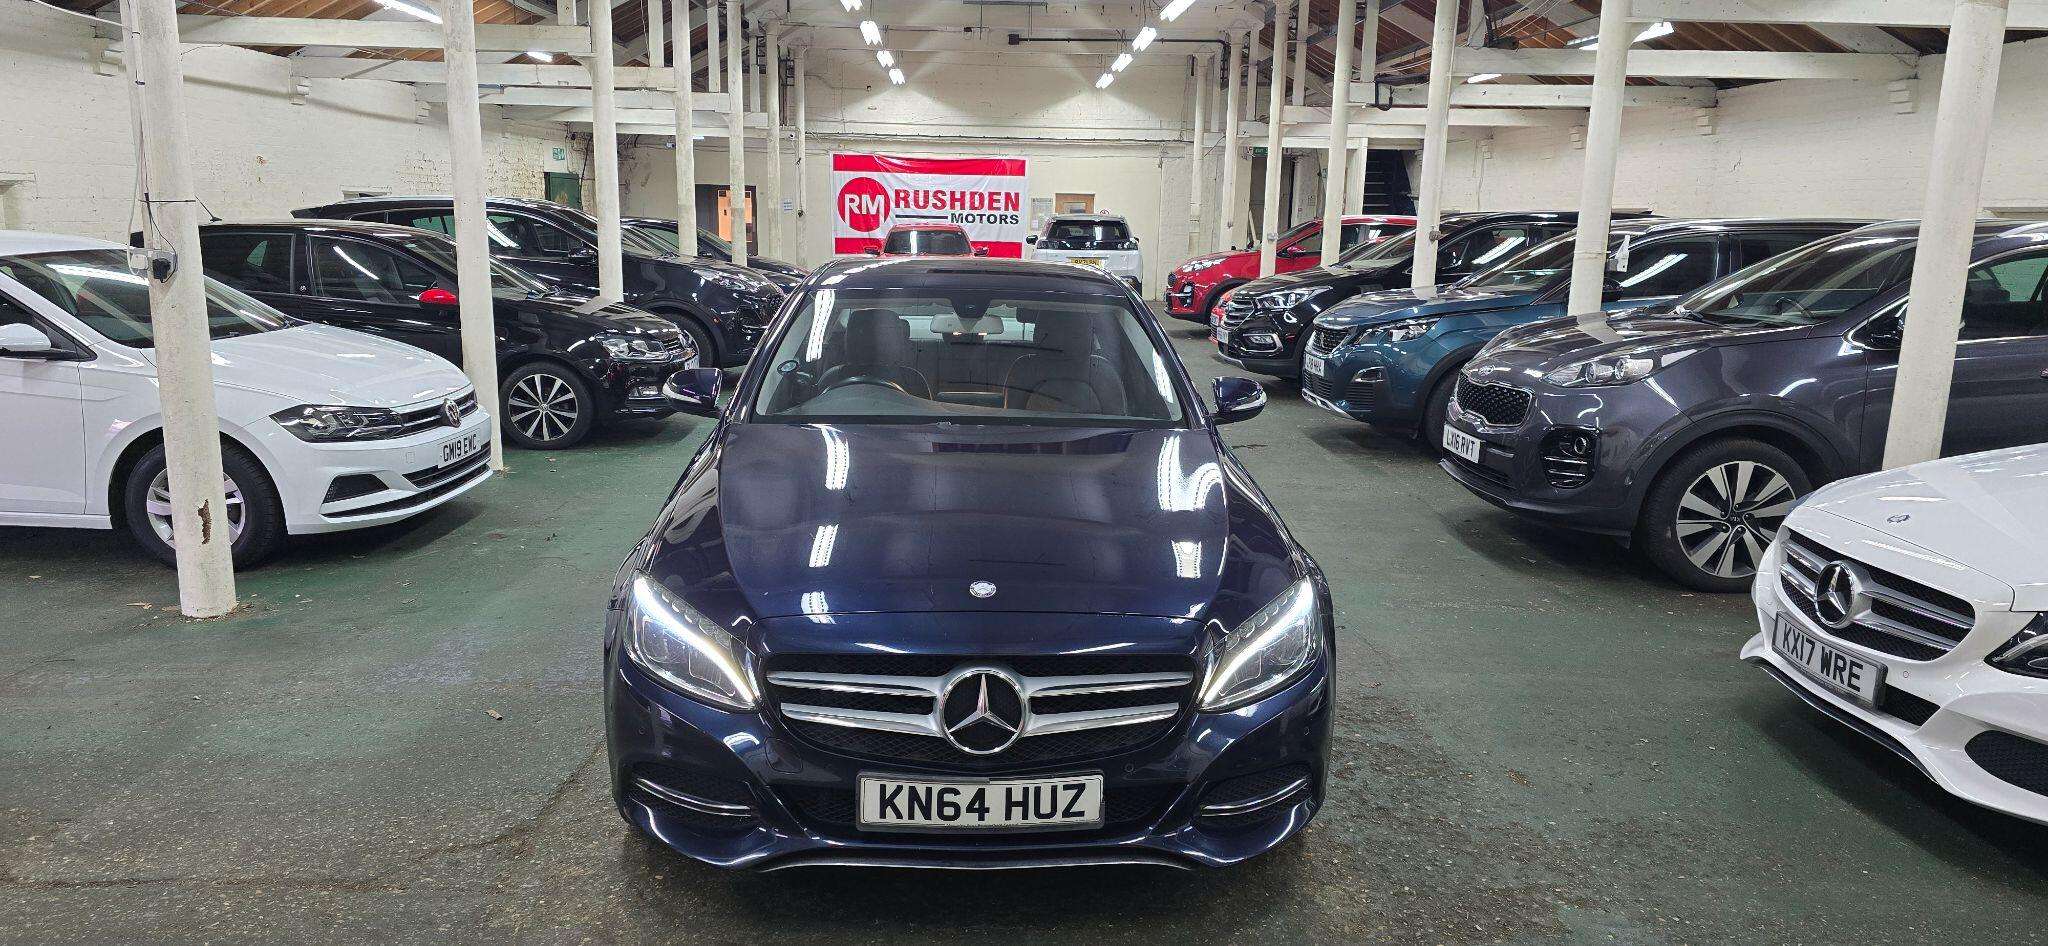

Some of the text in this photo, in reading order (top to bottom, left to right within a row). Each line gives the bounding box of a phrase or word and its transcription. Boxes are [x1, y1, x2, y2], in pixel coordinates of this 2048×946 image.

[844, 193, 885, 219] RM
[894, 188, 1020, 212] RUSHDEN
[950, 212, 1020, 225] MOTORS
[442, 439, 462, 462] GM19
[1461, 435, 1476, 457] RVT
[1782, 622, 1816, 666] KX17
[1820, 645, 1864, 693] WRE
[879, 782, 1086, 822] KN64 HUZ
